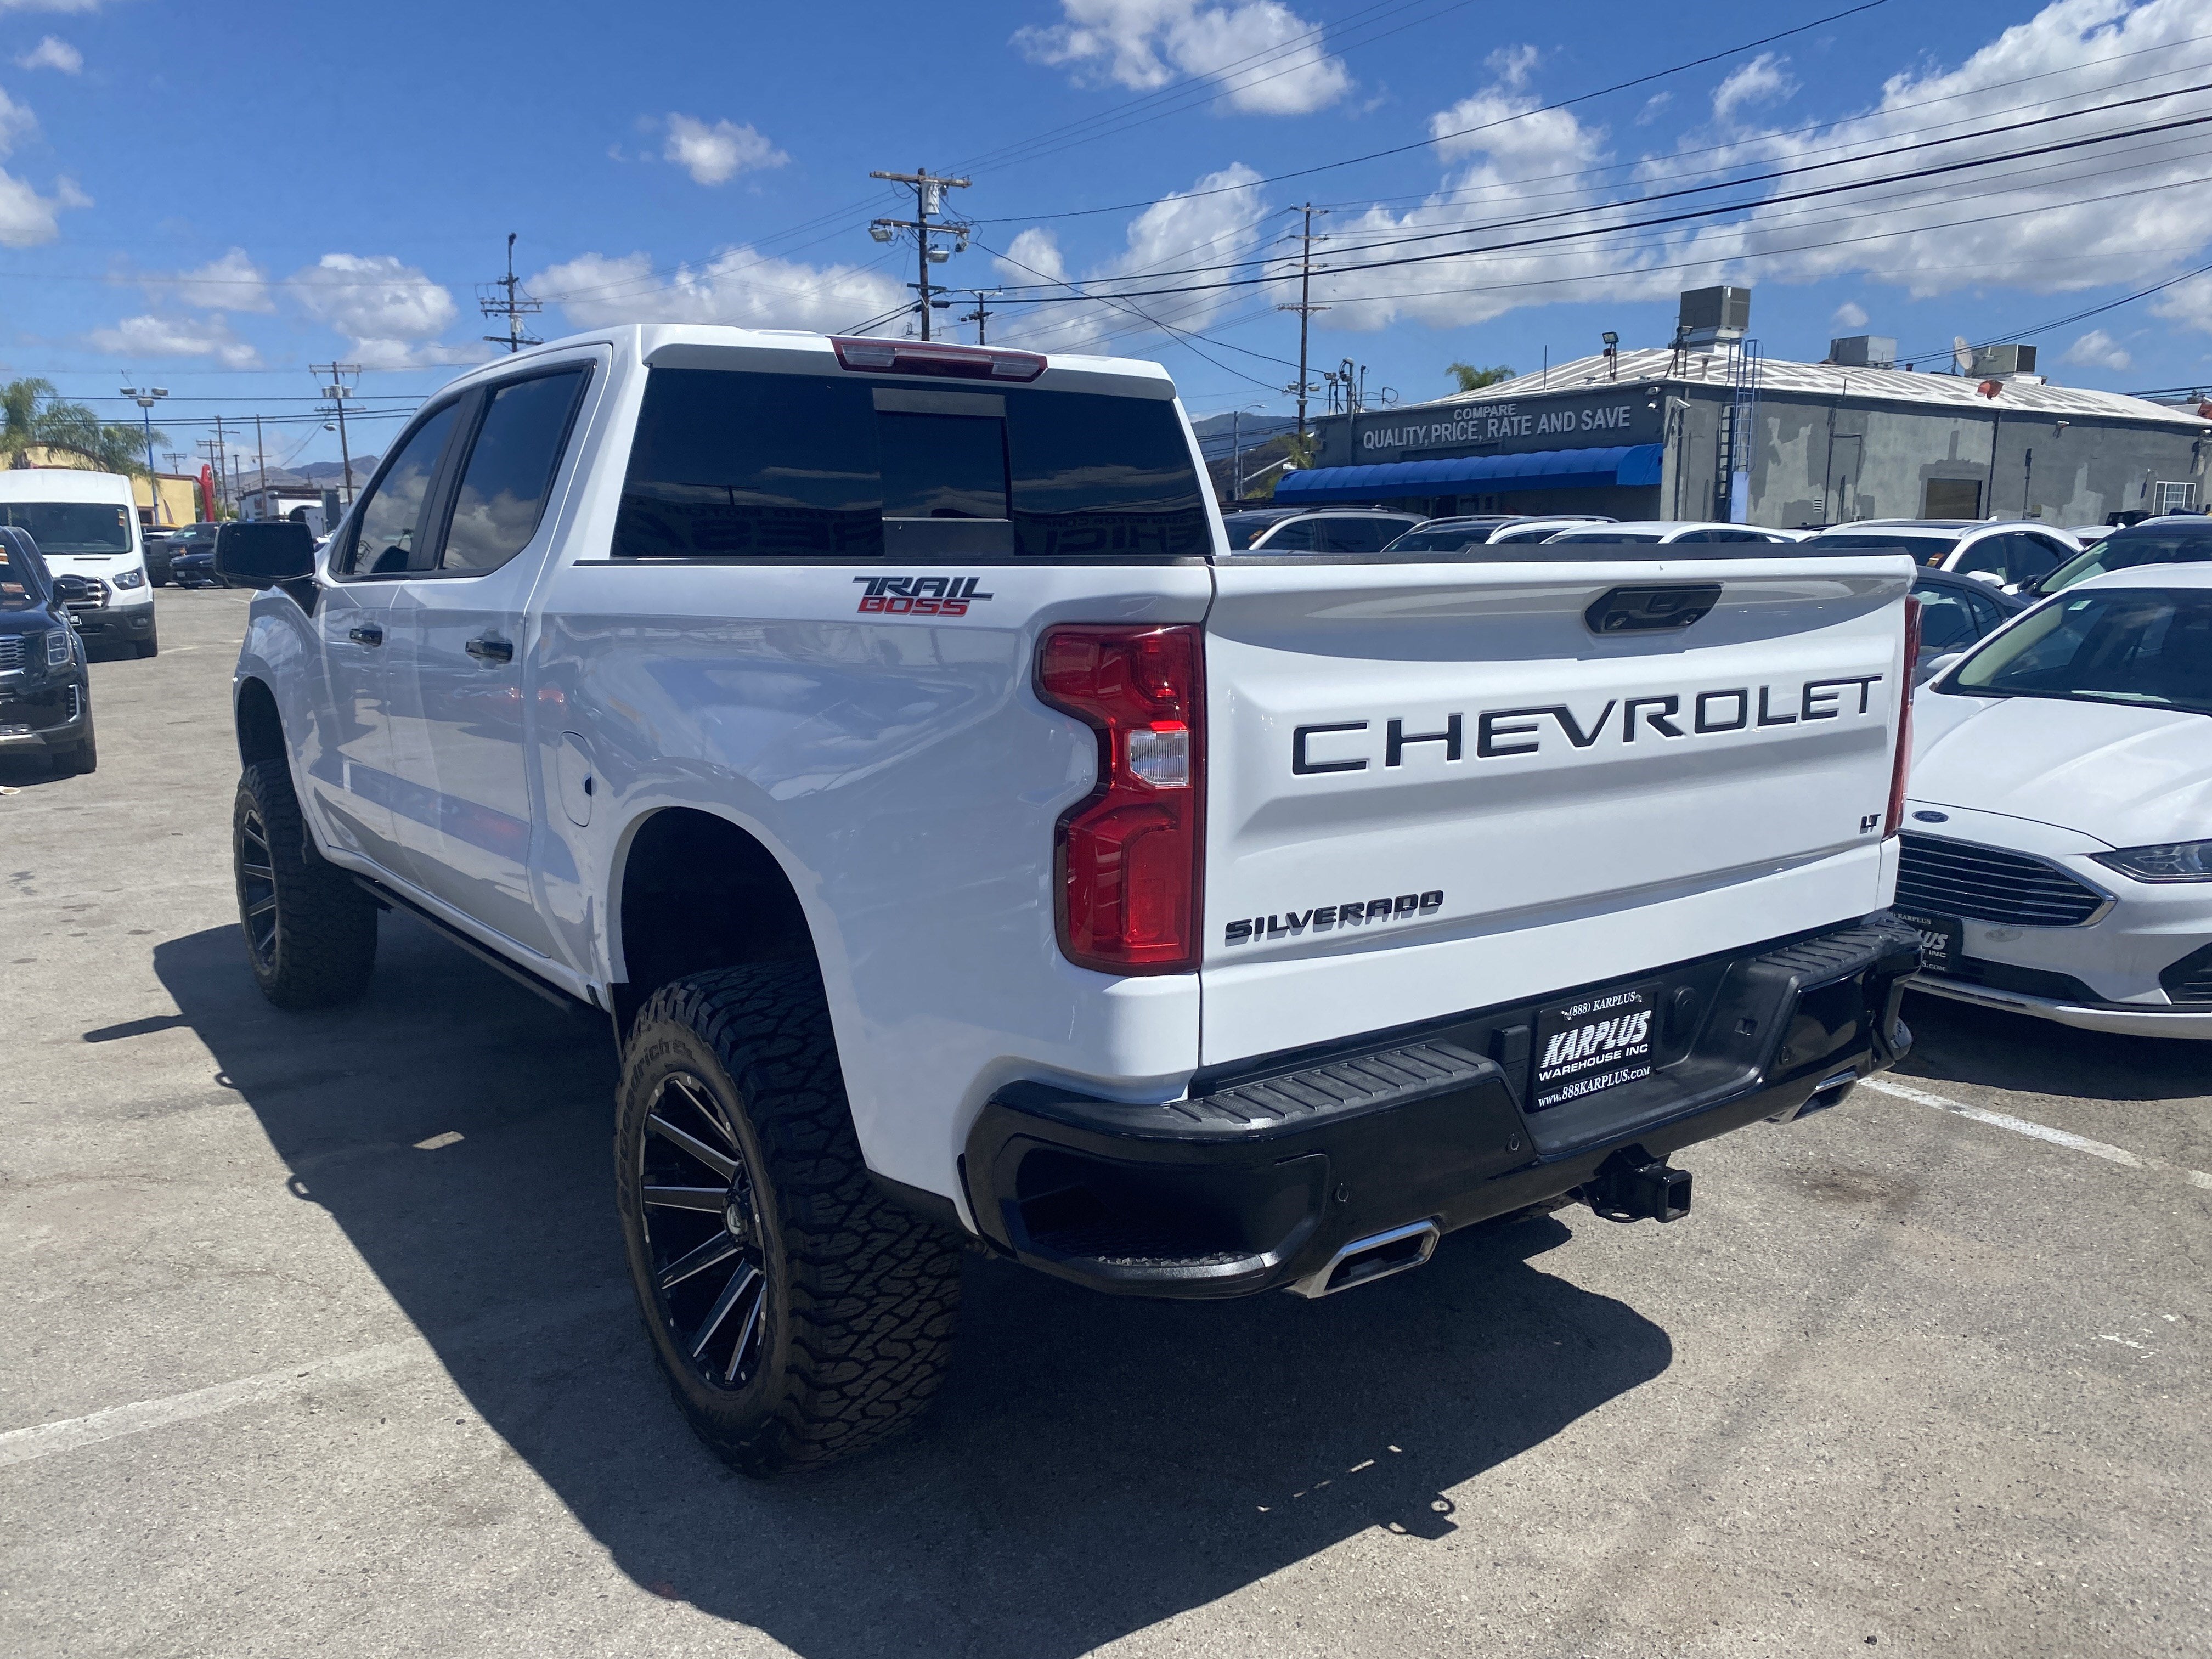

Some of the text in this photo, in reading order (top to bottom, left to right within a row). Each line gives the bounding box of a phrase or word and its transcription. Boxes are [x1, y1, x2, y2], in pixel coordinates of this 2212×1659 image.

[1363, 405, 1631, 450] QUALITY, PRICE, RATE AND SAVE
[1454, 403, 1517, 421] COMPARE
[852, 575, 995, 601] TRAIL
[856, 595, 971, 617] BOSS
[1291, 674, 1884, 776] CHEVROLET
[1860, 813, 1881, 830] LT
[1224, 889, 1444, 941] SILVERADO
[1569, 991, 1636, 1017] (888) KARPLUS
[1539, 1009, 1652, 1068] KARPLUS
[1539, 1043, 1649, 1081] WAREHOUSE INC
